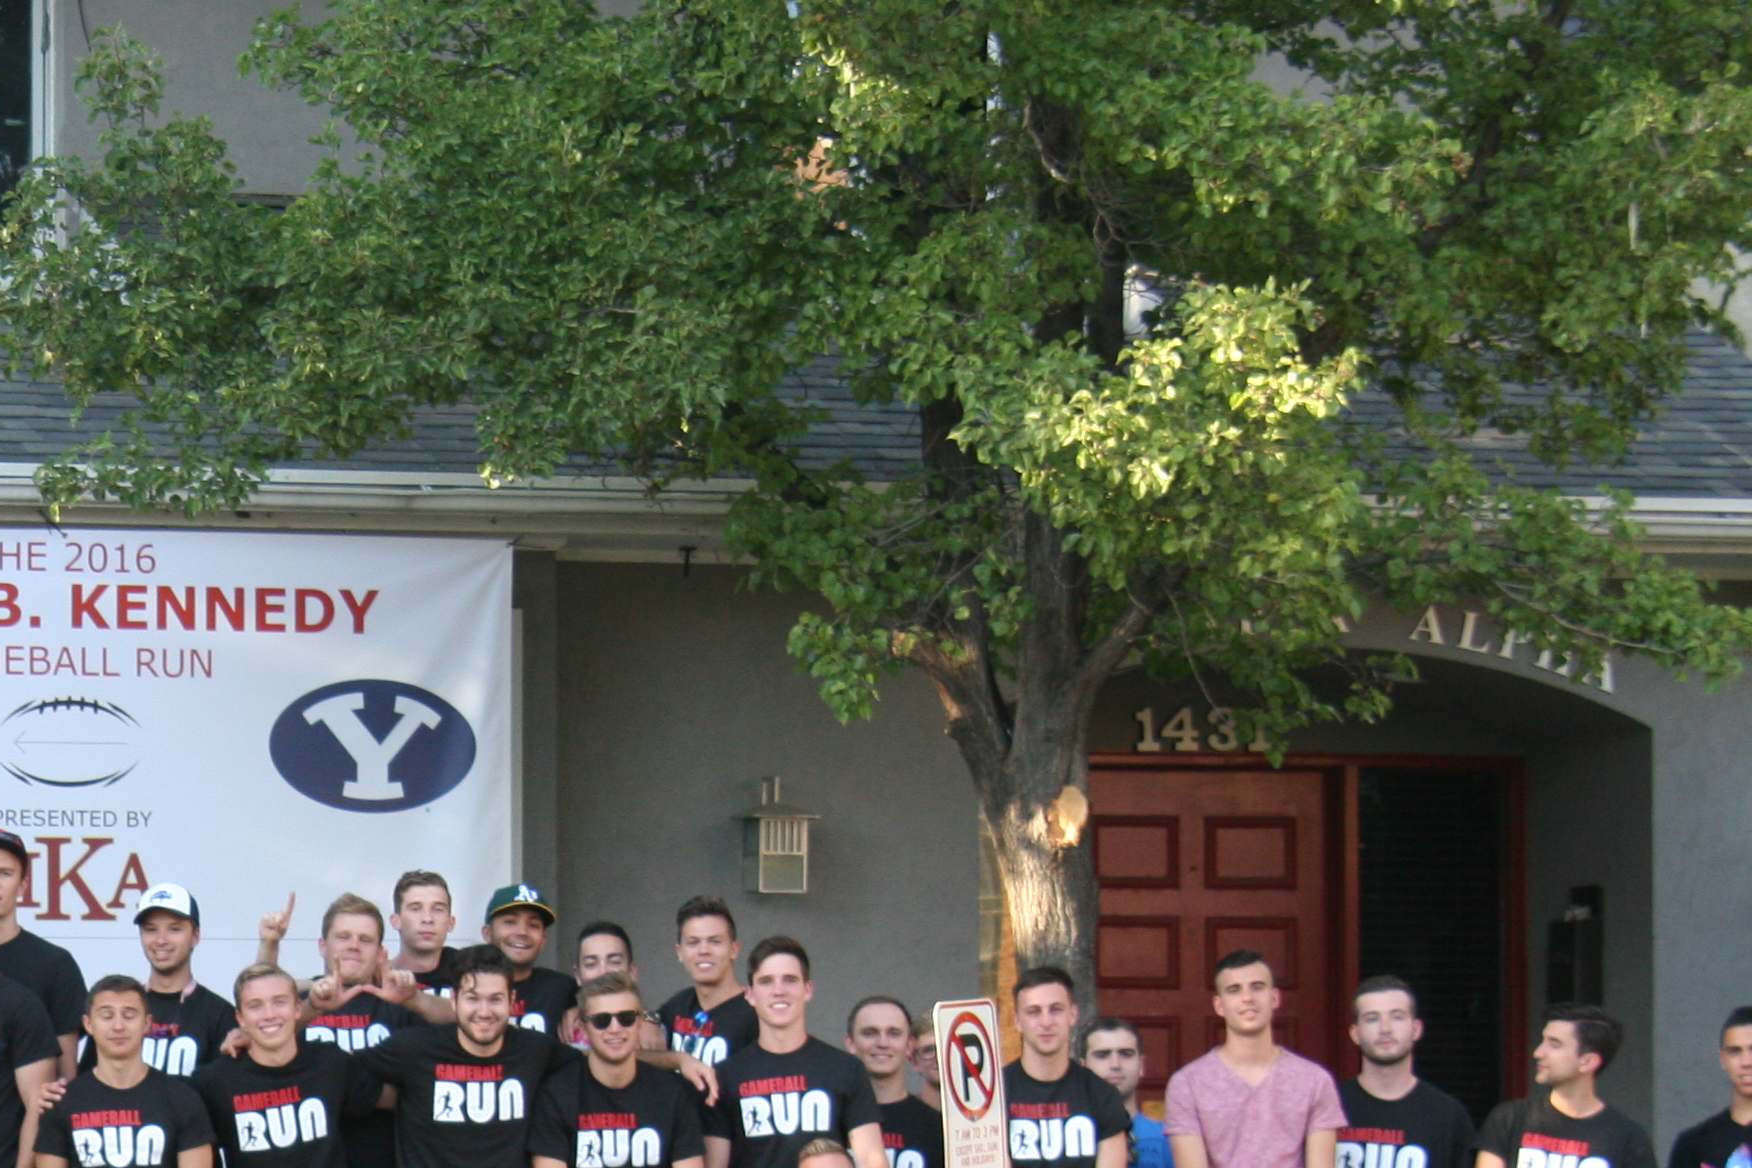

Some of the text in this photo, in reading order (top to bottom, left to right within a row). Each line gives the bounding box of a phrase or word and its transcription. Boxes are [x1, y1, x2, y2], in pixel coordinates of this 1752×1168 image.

[63, 542, 157, 575] 2016
[70, 584, 380, 635] KENNEDY
[136, 647, 214, 679] RUN
[303, 691, 442, 800] Y
[126, 810, 153, 828] BY
[141, 1035, 198, 1077] UN
[435, 1064, 504, 1083] GAMEBALL
[739, 1075, 808, 1098] GAMEBALL
[233, 1086, 302, 1113] GAMEBALL
[433, 1078, 524, 1124] RUN
[739, 1089, 831, 1138] RUN
[1009, 1102, 1071, 1119] GAMEBALL
[70, 1110, 143, 1129] GAMEBALL
[234, 1098, 328, 1152] RUN
[578, 1113, 637, 1131] GAMEBALL
[71, 1124, 165, 1168] RUN
[1009, 1115, 1096, 1161] RUN
[1337, 1127, 1406, 1146] GAMEBALL
[1521, 1132, 1590, 1154] GAMEBALL
